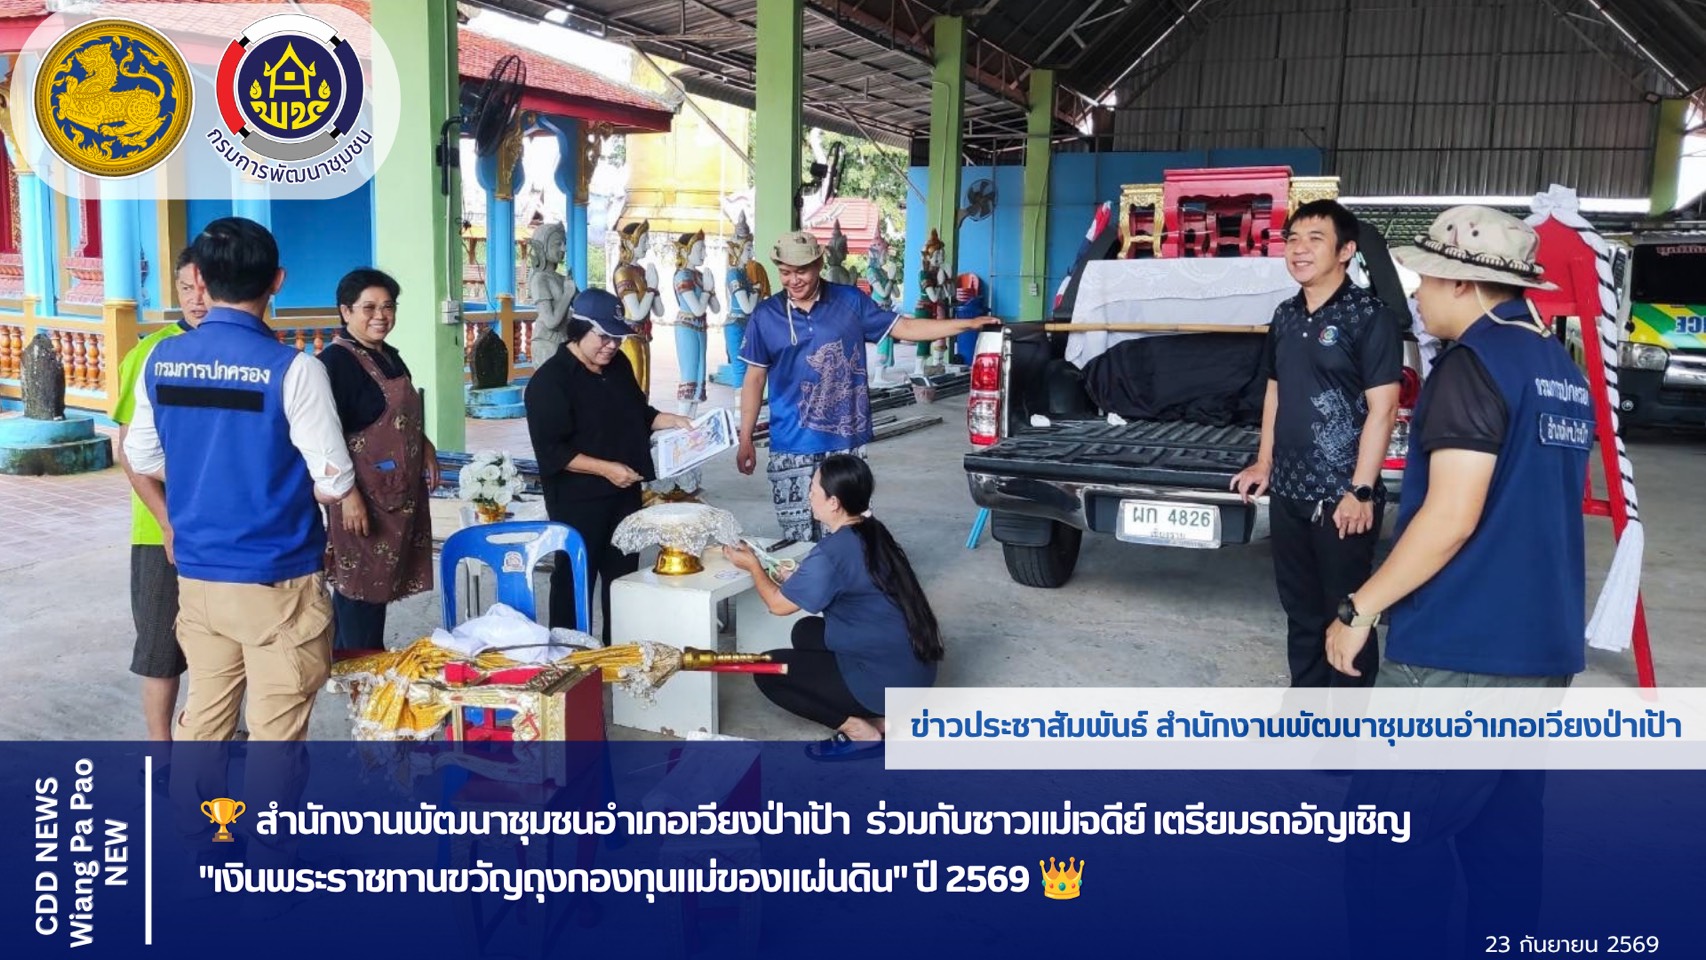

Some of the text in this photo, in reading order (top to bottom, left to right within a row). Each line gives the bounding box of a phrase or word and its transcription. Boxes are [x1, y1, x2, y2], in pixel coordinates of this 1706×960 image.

[154, 359, 271, 385] กรมการปกครอง
[1168, 509, 1211, 528] 4826
